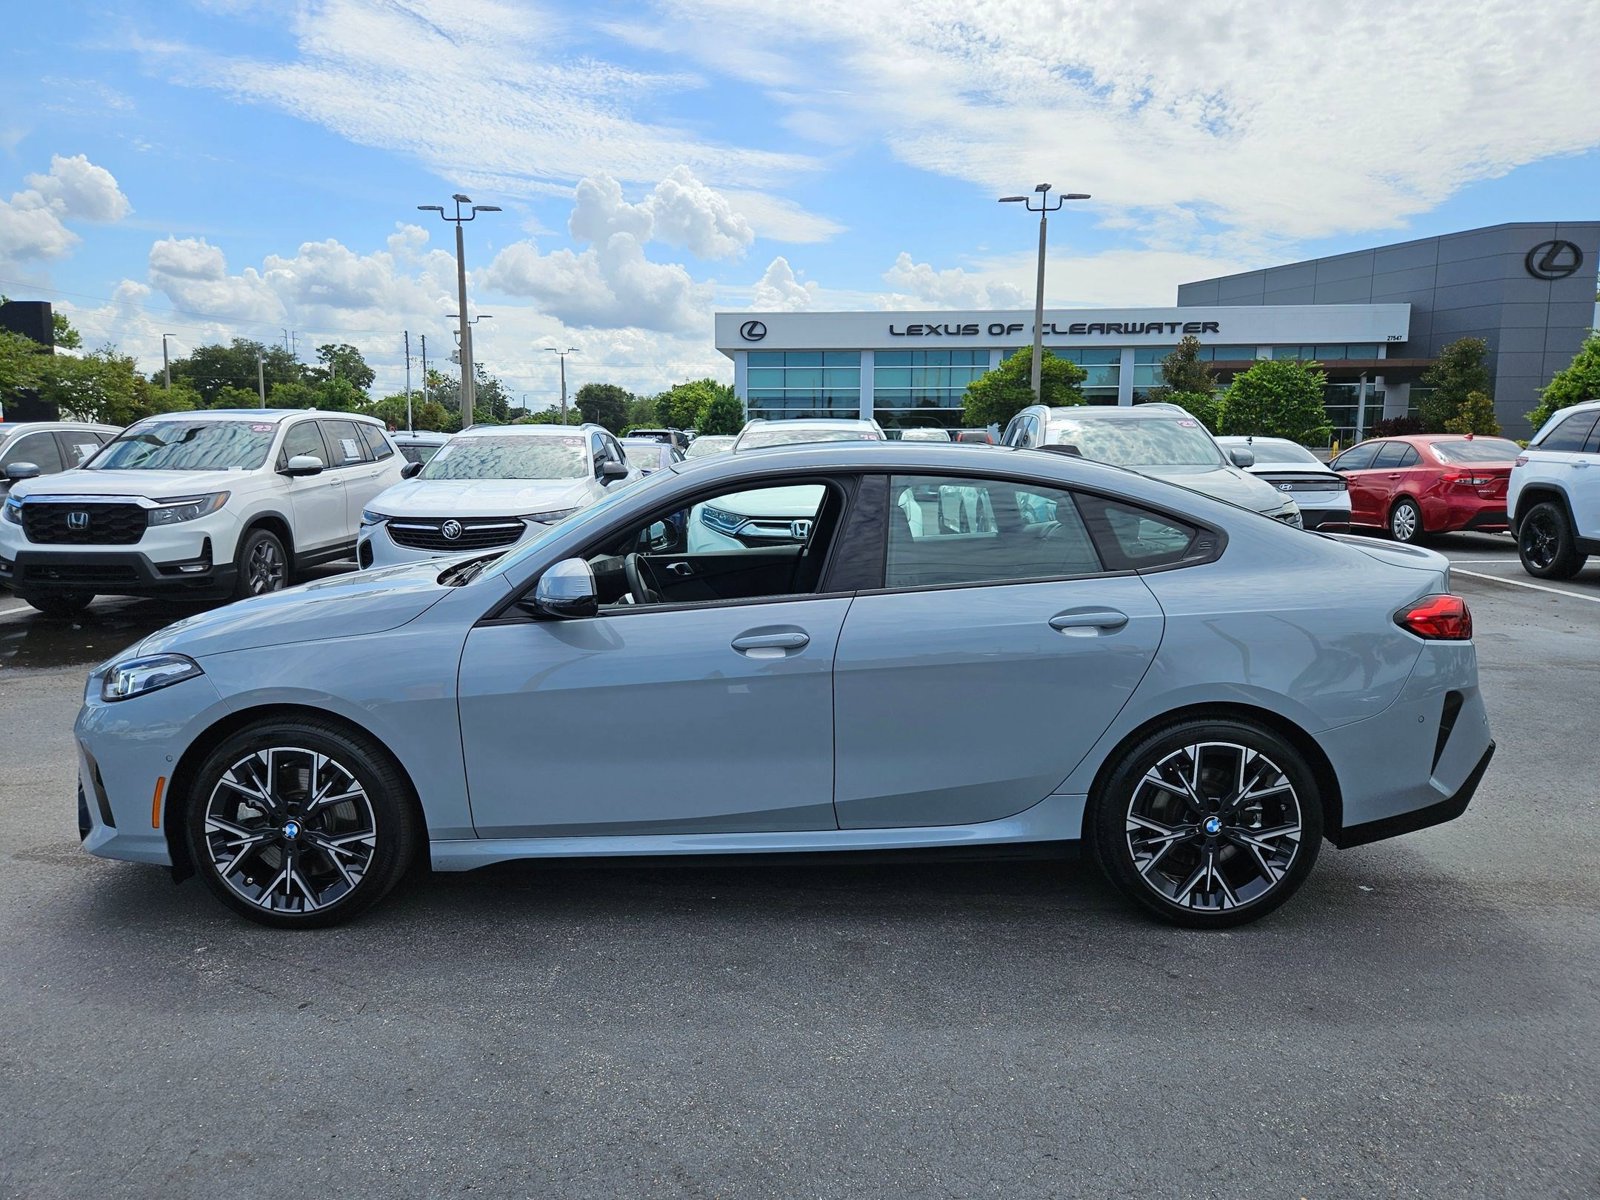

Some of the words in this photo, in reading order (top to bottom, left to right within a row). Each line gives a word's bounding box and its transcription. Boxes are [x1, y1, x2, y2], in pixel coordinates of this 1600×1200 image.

[889, 324, 980, 336] LEXUS
[988, 323, 1025, 335] OF
[1032, 321, 1220, 335] CLEARWATER
